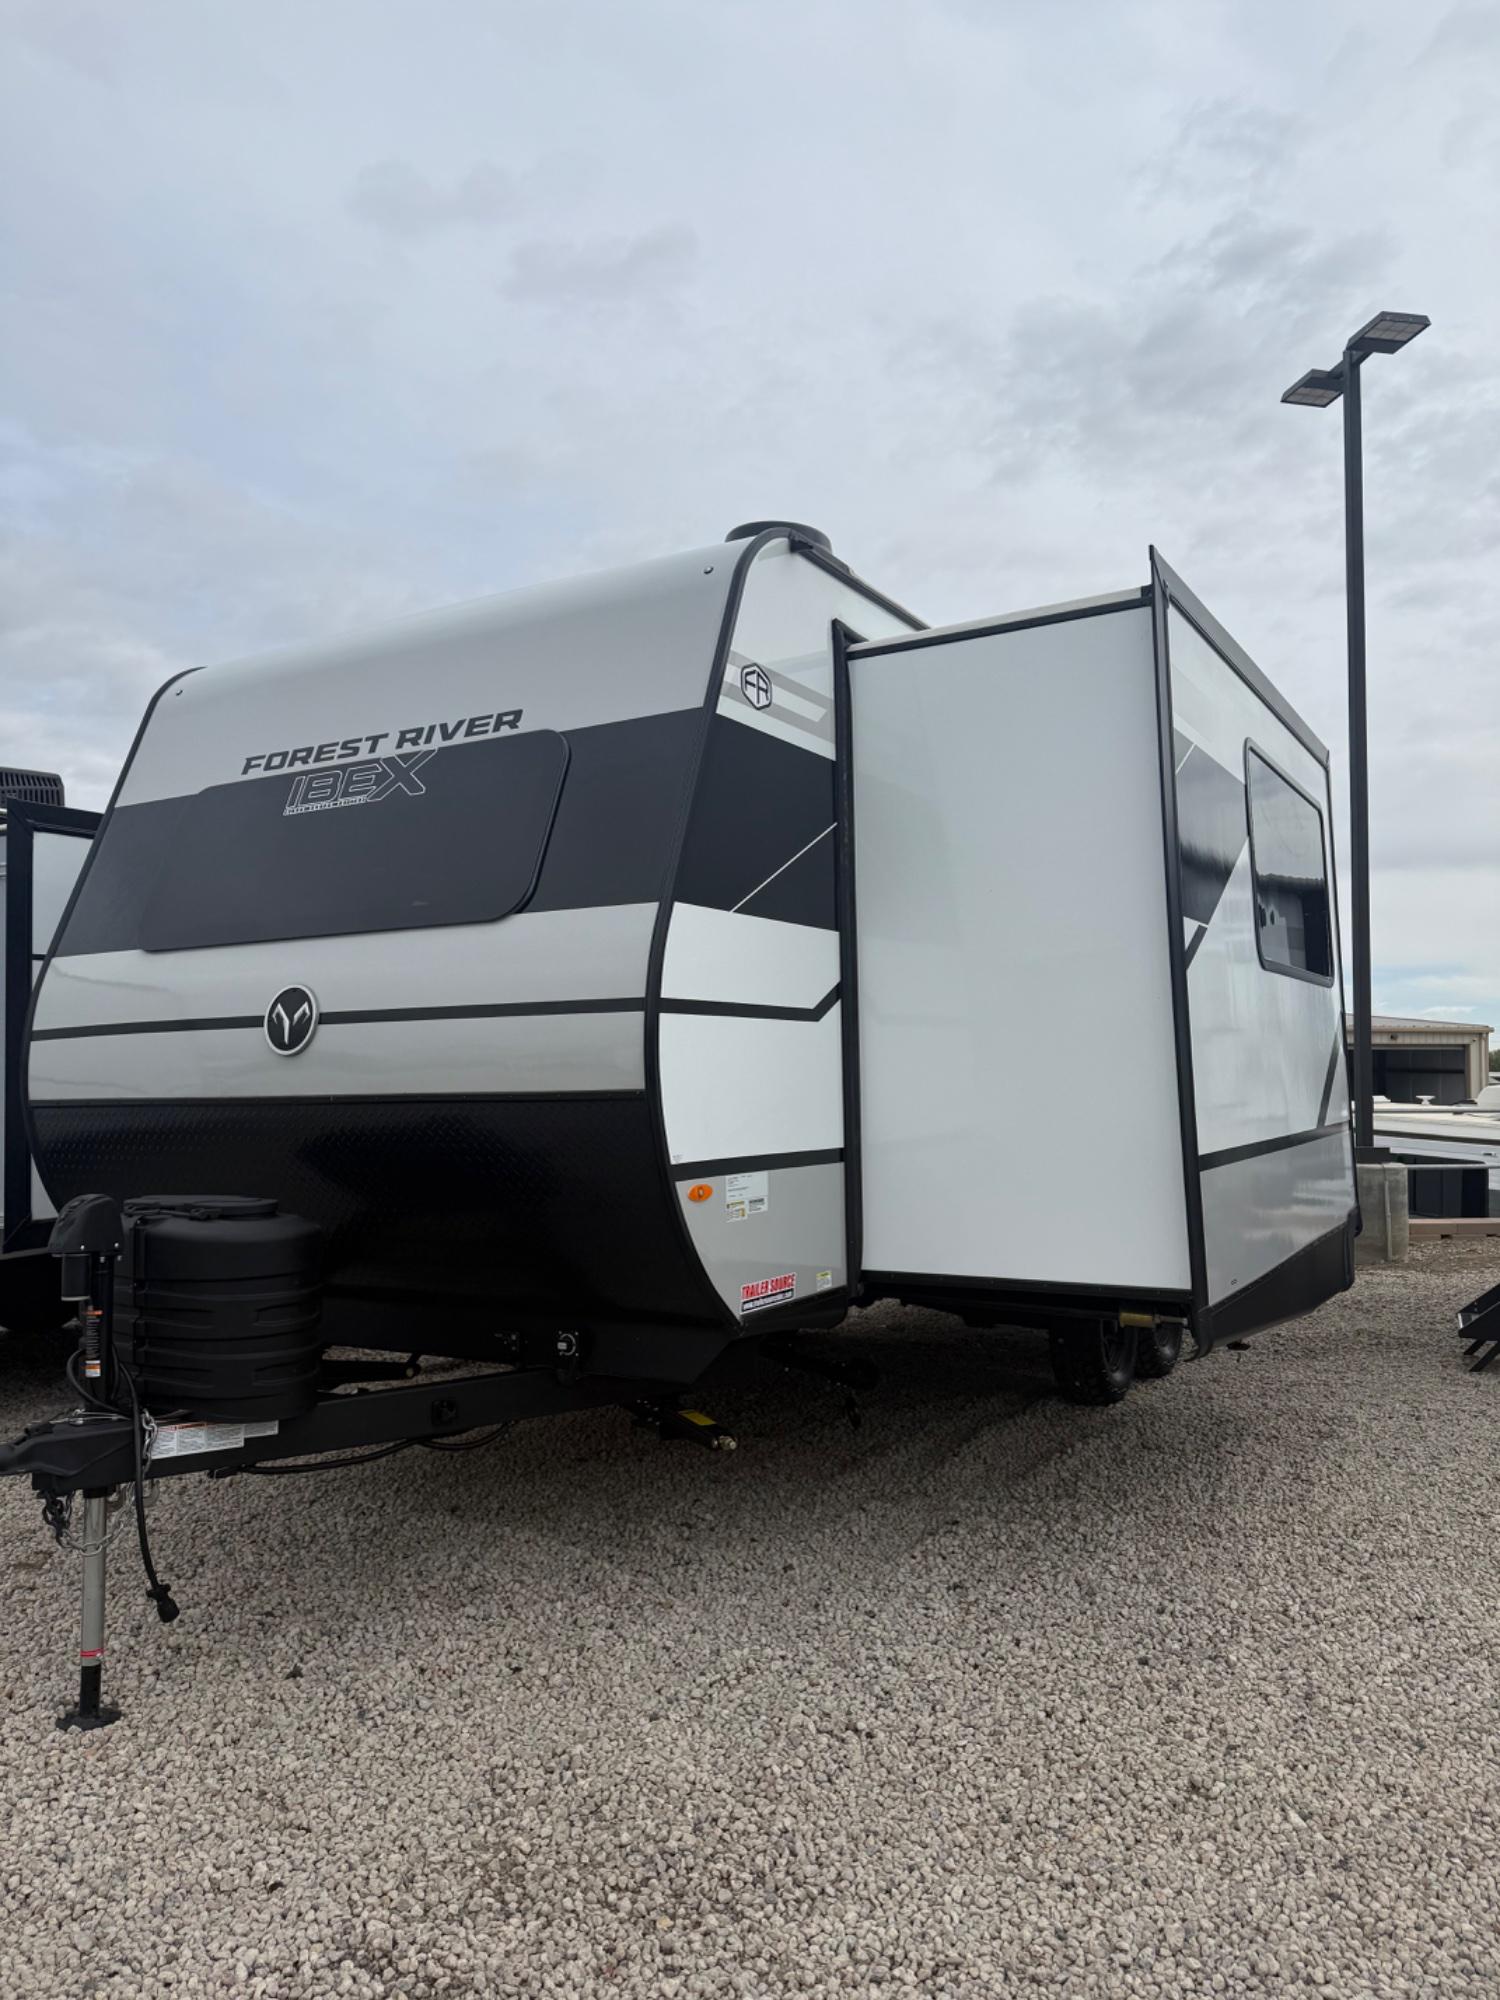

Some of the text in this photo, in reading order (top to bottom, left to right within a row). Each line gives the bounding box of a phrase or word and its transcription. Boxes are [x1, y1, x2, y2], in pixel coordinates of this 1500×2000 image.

[241, 709, 523, 775] FOREST RIVER
[284, 748, 438, 808] IBEX
[742, 1280, 769, 1299] TRAILER
[770, 1273, 795, 1291] SOURCE
